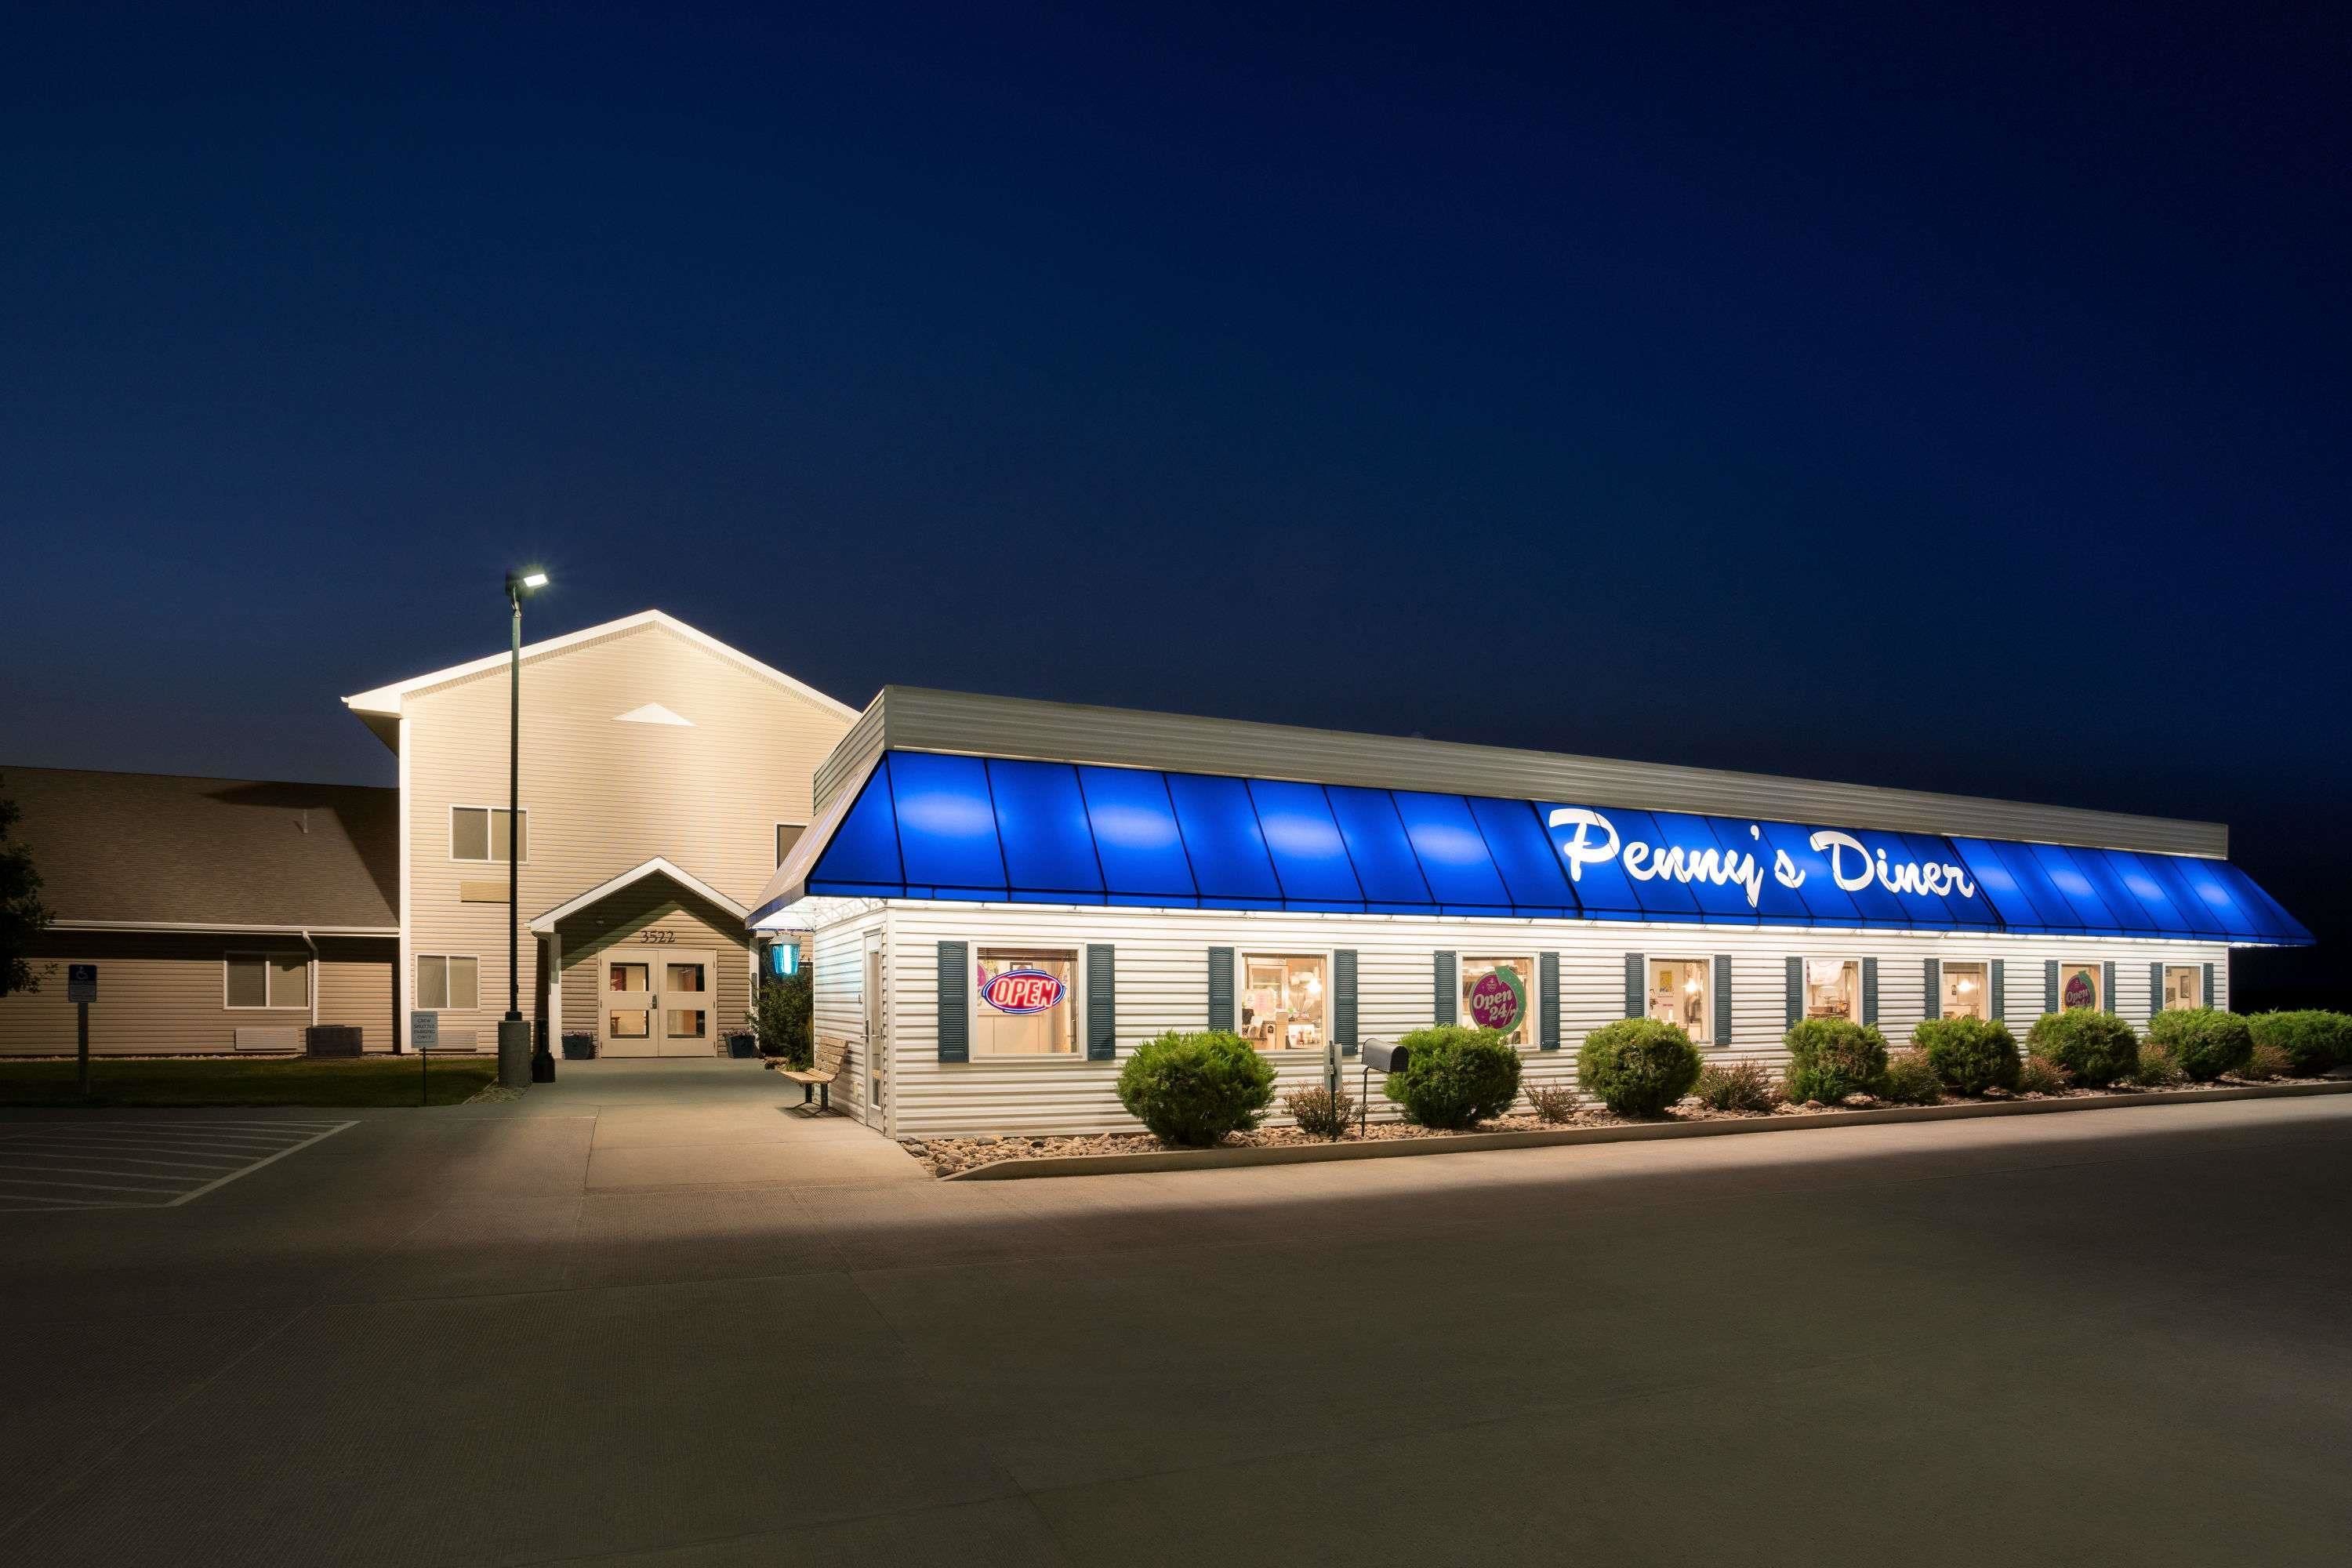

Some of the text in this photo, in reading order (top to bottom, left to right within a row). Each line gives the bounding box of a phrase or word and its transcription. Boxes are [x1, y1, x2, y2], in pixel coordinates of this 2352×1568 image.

[1549, 808, 1974, 908] Penny's Diner
[640, 931, 676, 943] 3522
[993, 978, 1056, 1007] OPEN
[1473, 989, 1513, 1011] Open
